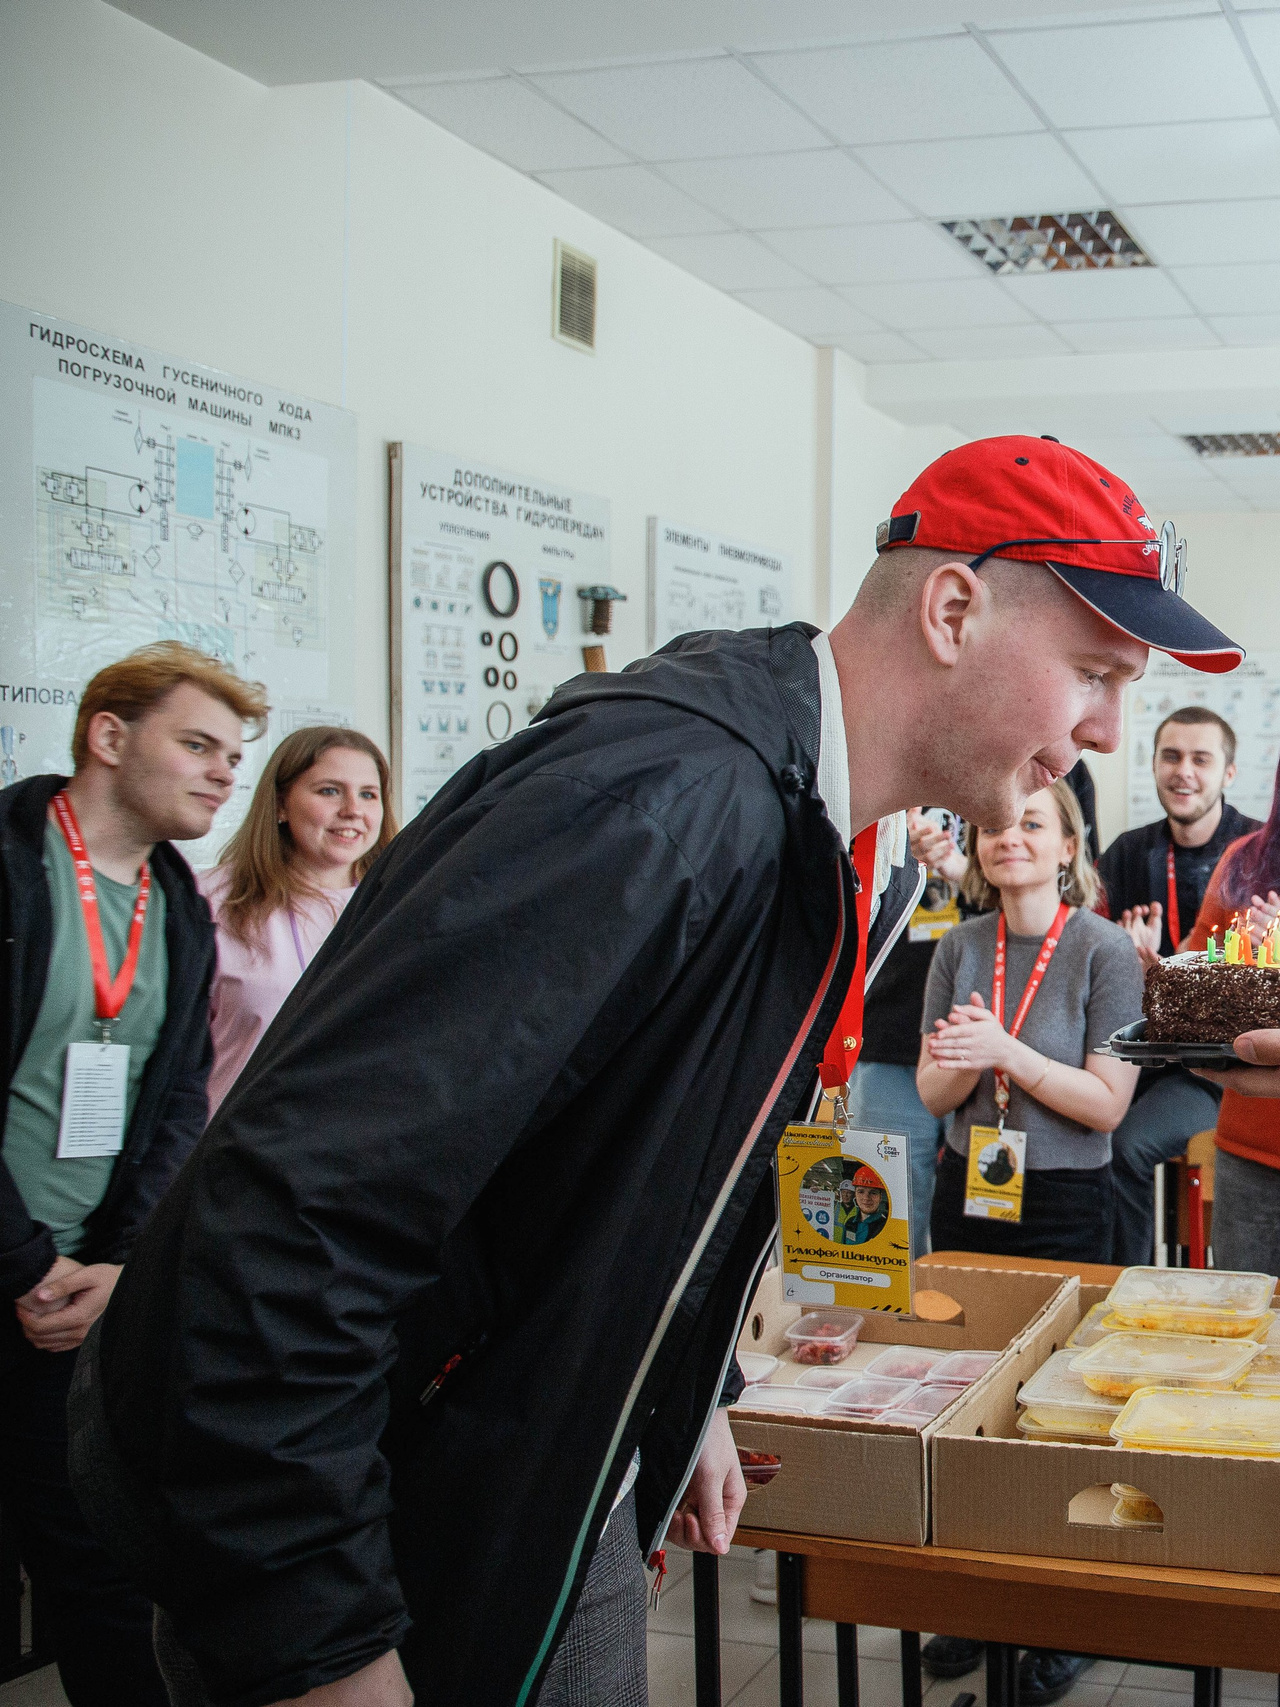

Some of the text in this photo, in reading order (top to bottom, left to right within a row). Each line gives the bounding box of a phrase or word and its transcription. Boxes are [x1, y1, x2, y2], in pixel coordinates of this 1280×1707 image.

[29, 323, 313, 422] ГИДРОСХЕМА ГУСЕНИЧНОГО ХОДА
[58, 358, 176, 405] ПОГРУЗОЧНОЙ
[188, 397, 252, 427] МАШИНЫ
[420, 482, 510, 518] УСТРОЙСТВА
[453, 469, 573, 514] ДОПОЛНИТЕЛЬНЫЕ
[0, 685, 79, 707] ТИПОВА
[785, 1244, 907, 1267] Тимофей Шанауров
[819, 1270, 874, 1284] Организатор
